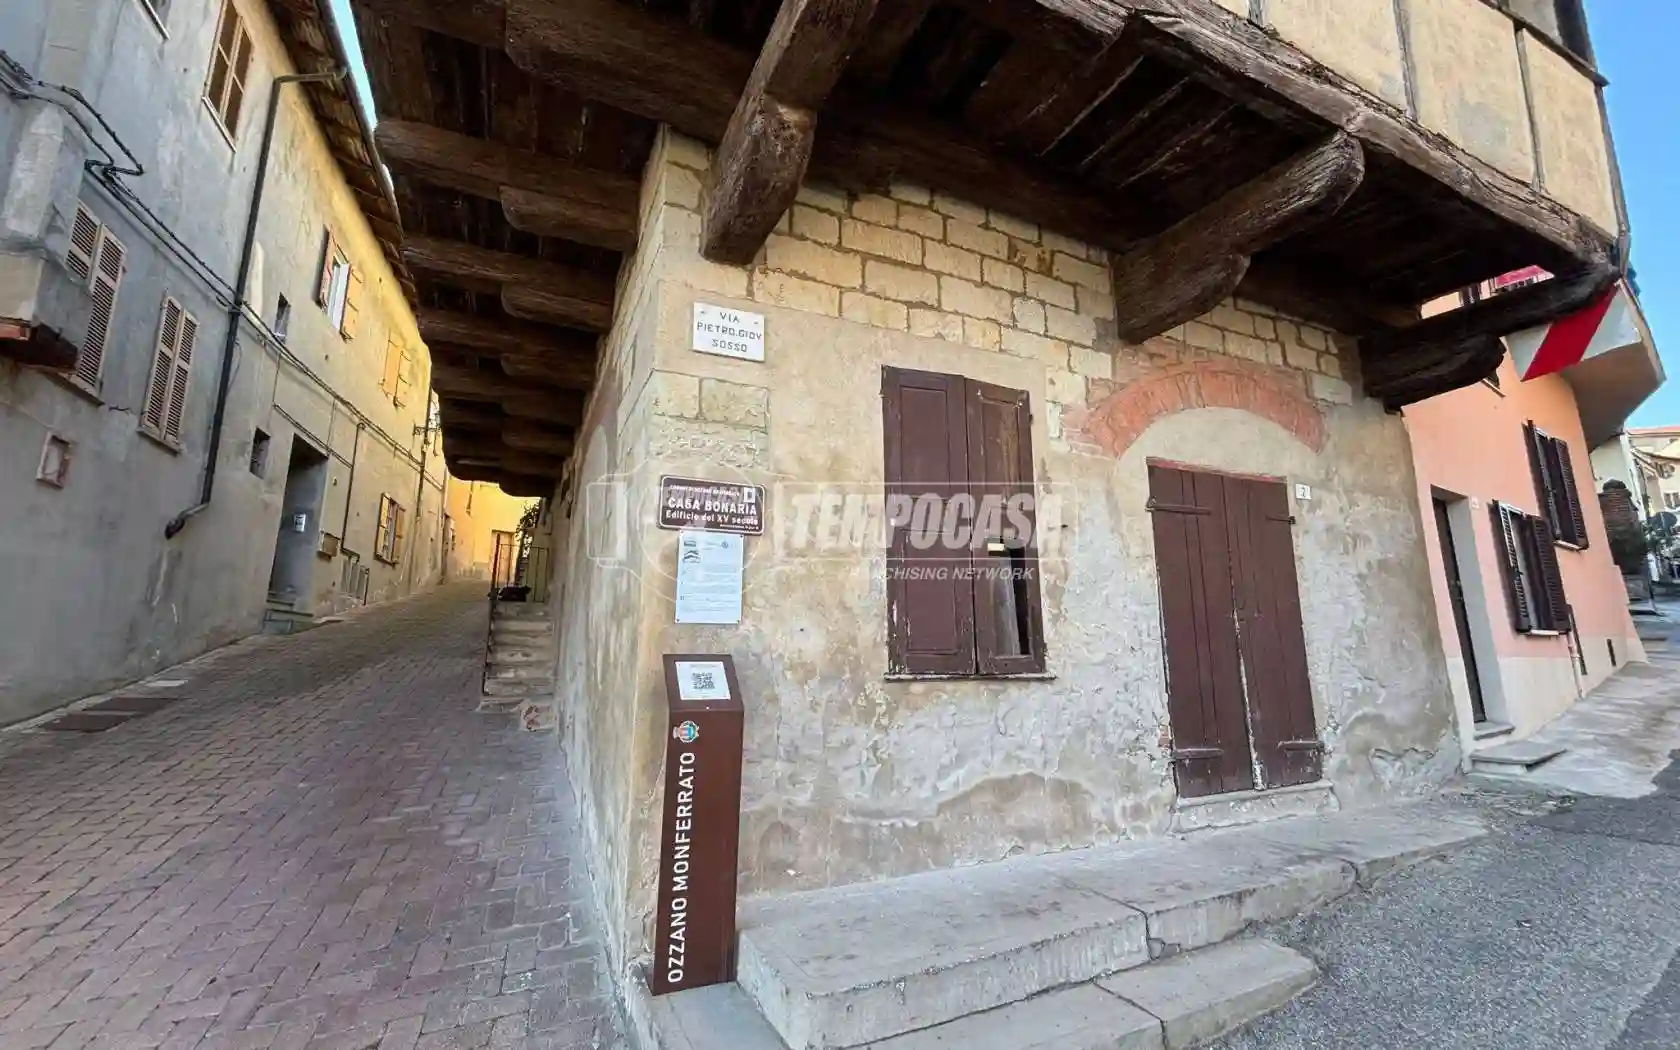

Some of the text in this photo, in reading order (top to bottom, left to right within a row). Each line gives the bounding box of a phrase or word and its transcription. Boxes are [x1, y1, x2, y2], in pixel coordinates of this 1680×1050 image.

[719, 311, 740, 324] VIA
[711, 338, 748, 353] SOSSO
[667, 497, 757, 515] CASA BONARIA
[666, 510, 699, 521] Edificio
[701, 513, 715, 522] del
[717, 514, 729, 523] XV
[667, 751, 696, 984] OZZANO MONFERRATO
